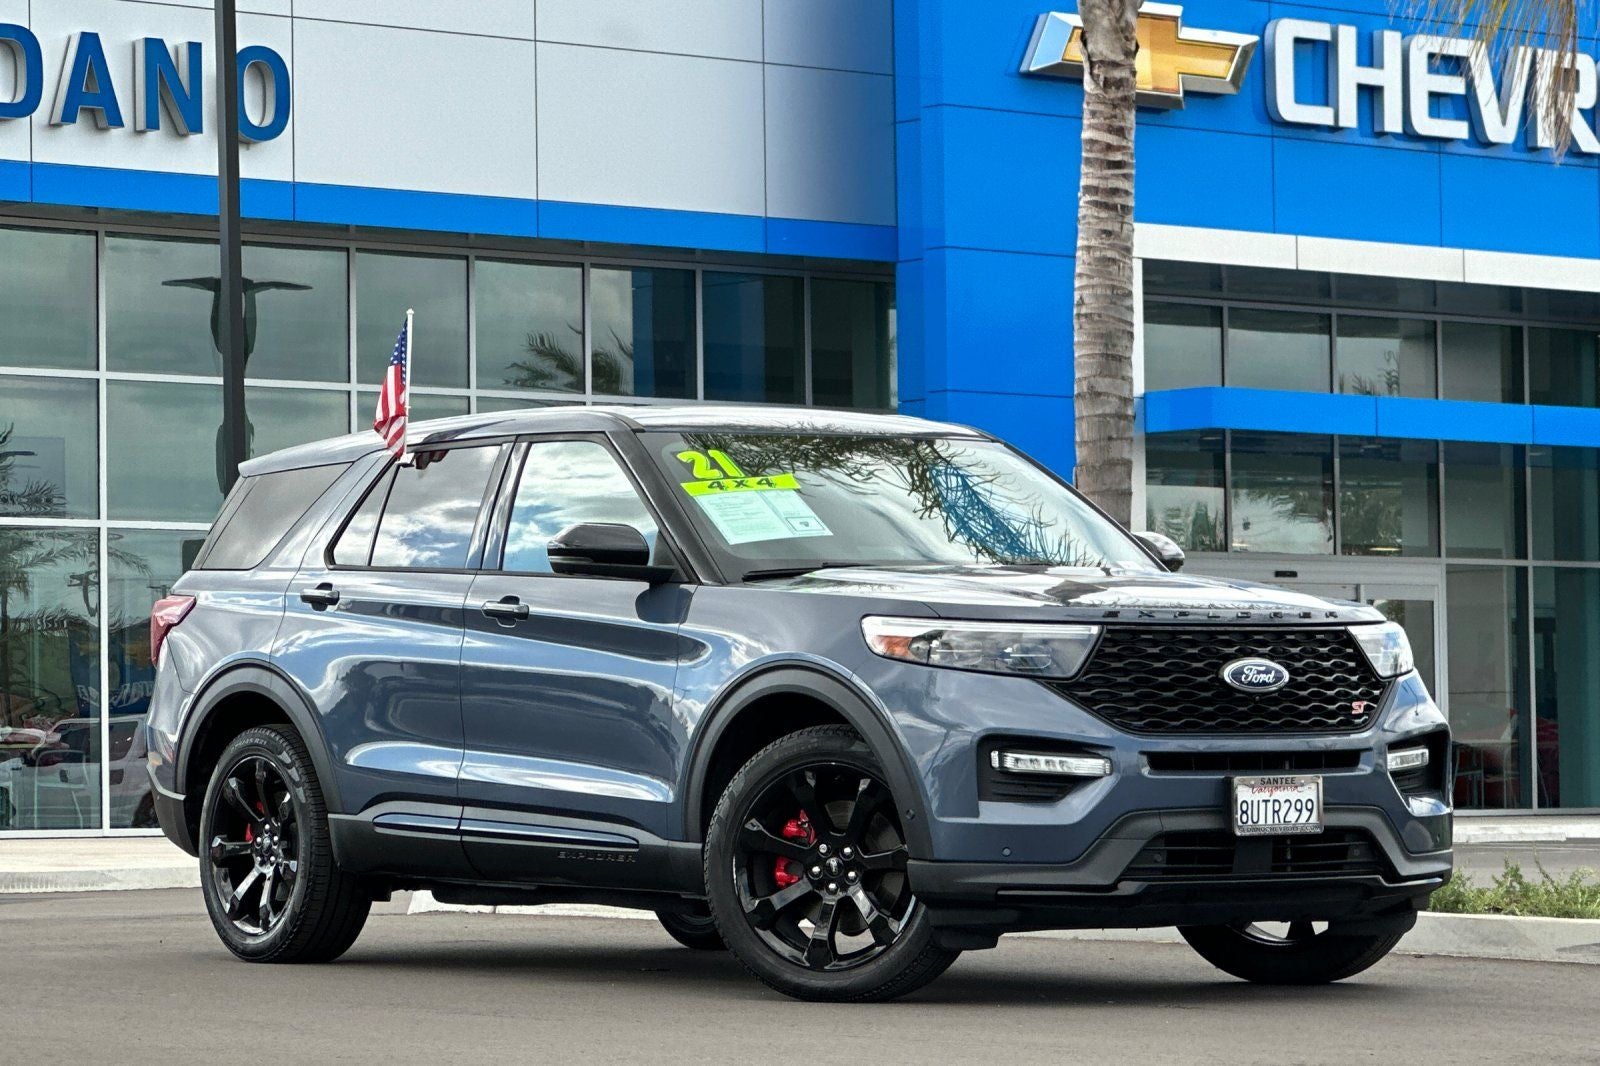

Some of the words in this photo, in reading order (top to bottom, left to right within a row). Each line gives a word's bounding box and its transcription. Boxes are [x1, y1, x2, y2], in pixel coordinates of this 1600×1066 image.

[676, 449, 745, 479] 21
[1102, 610, 1338, 619] EXPLORER
[1241, 665, 1276, 684] Ford
[1352, 701, 1366, 714] ST
[1260, 776, 1296, 786] SANTEE
[1239, 798, 1314, 825] 8UTR299
[558, 851, 636, 863] EXPLORER
